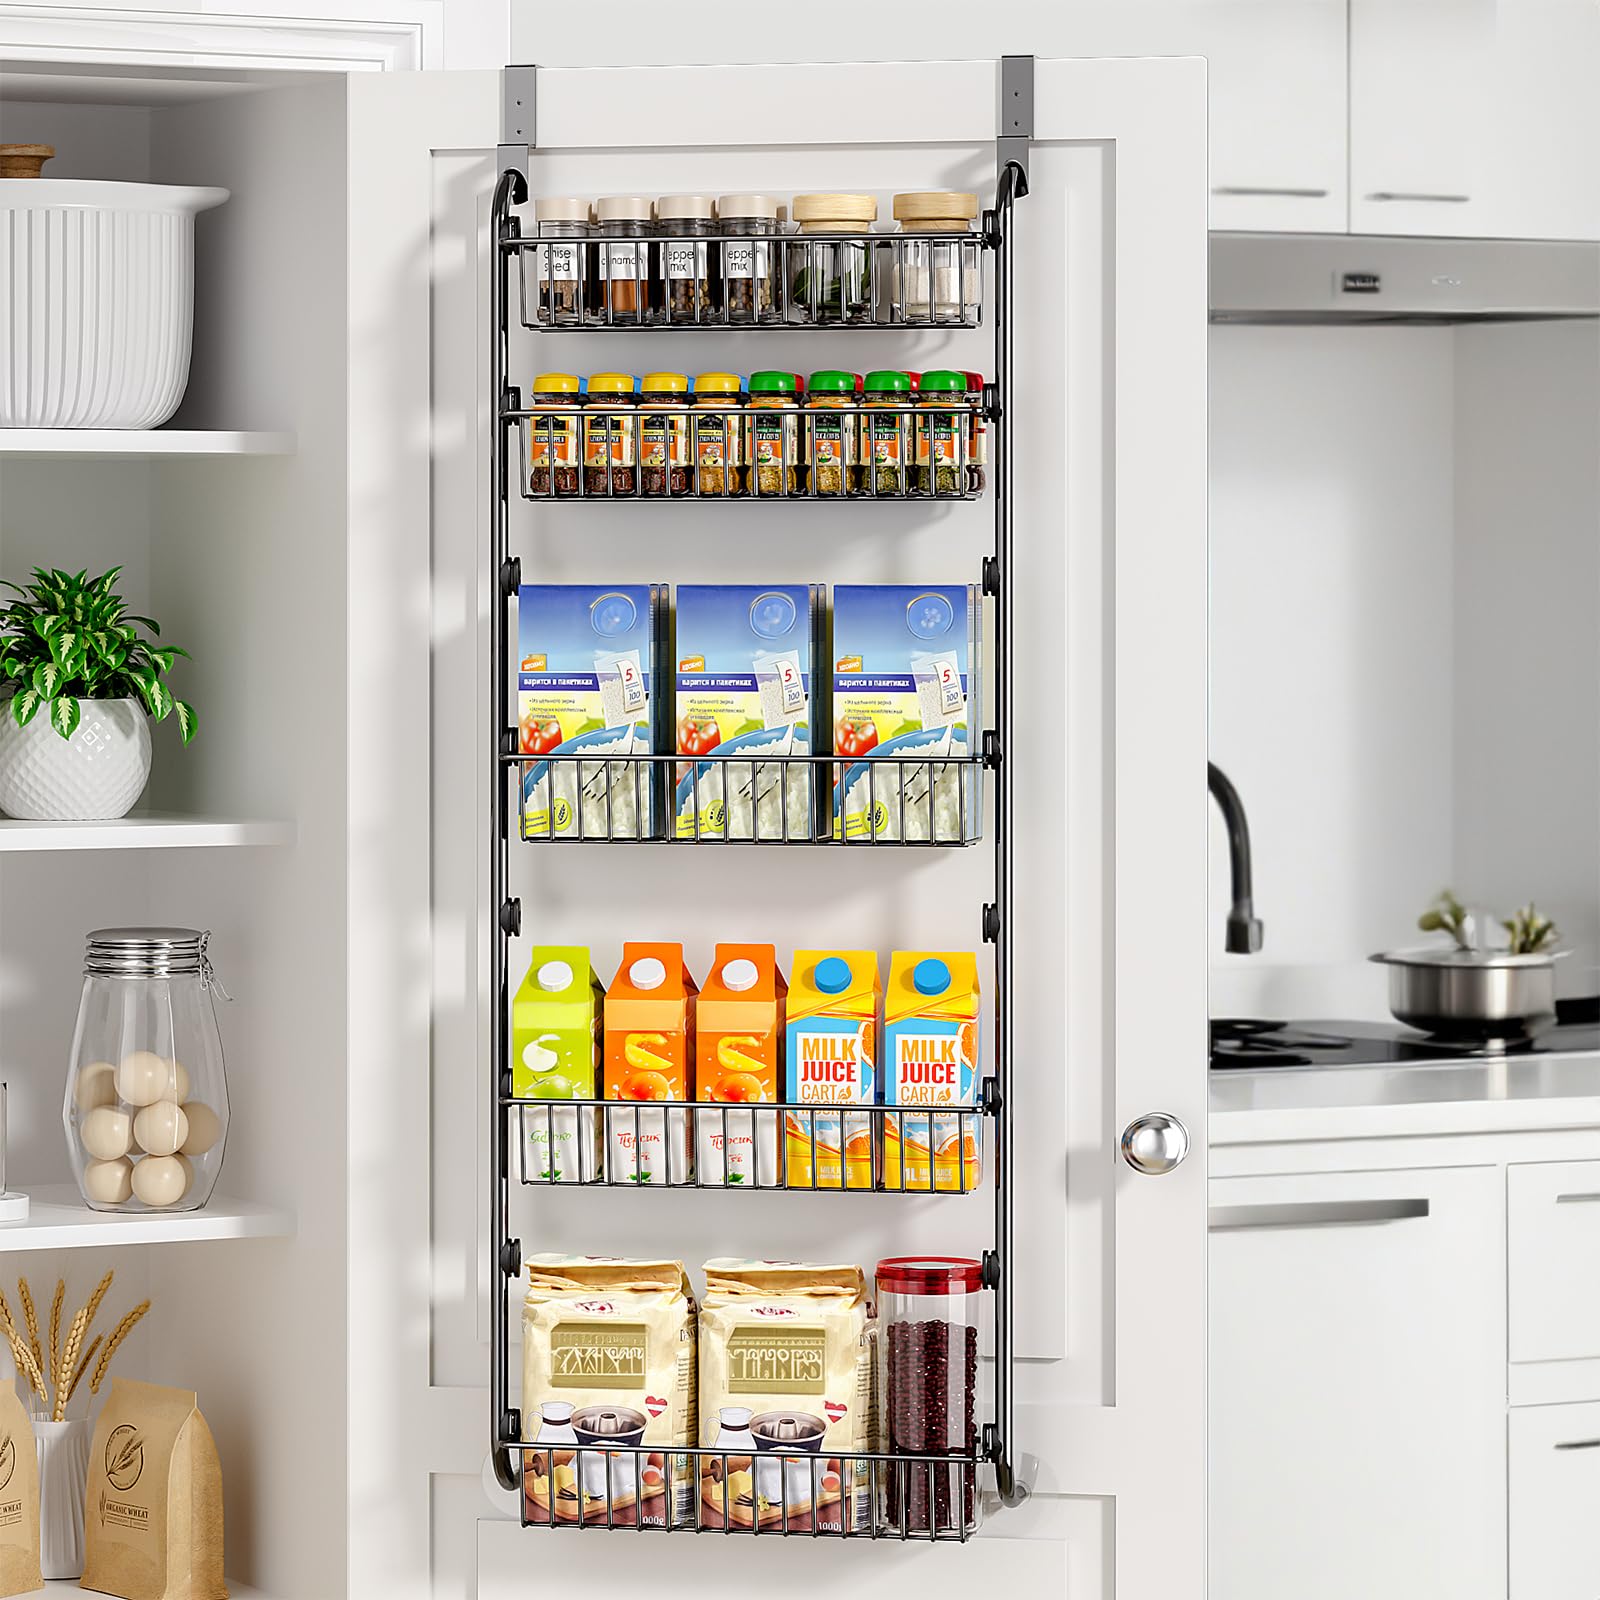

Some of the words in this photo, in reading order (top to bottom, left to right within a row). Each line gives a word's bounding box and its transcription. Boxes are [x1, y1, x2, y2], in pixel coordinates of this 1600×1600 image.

[601, 257, 643, 265] cnamon
[662, 250, 694, 262] eppe
[544, 260, 570, 272] sed
[670, 263, 687, 271] mix
[730, 262, 747, 271] mix
[625, 668, 633, 682] 5
[784, 669, 793, 682] 5
[942, 669, 951, 683] 5
[629, 691, 640, 701] 100
[788, 691, 800, 702] 100
[946, 692, 958, 702] 100
[802, 1038, 856, 1061] MILK
[901, 1040, 956, 1063] MILK
[801, 1061, 857, 1082] JUICE
[900, 1063, 956, 1084] JUICE
[801, 1084, 837, 1100] CART
[901, 1086, 936, 1102] CART
[905, 1168, 918, 1181] 1L
[106, 1503, 127, 1515] ORGANIC
[128, 1507, 148, 1519] WHEAT
[642, 1516, 664, 1525] 000g
